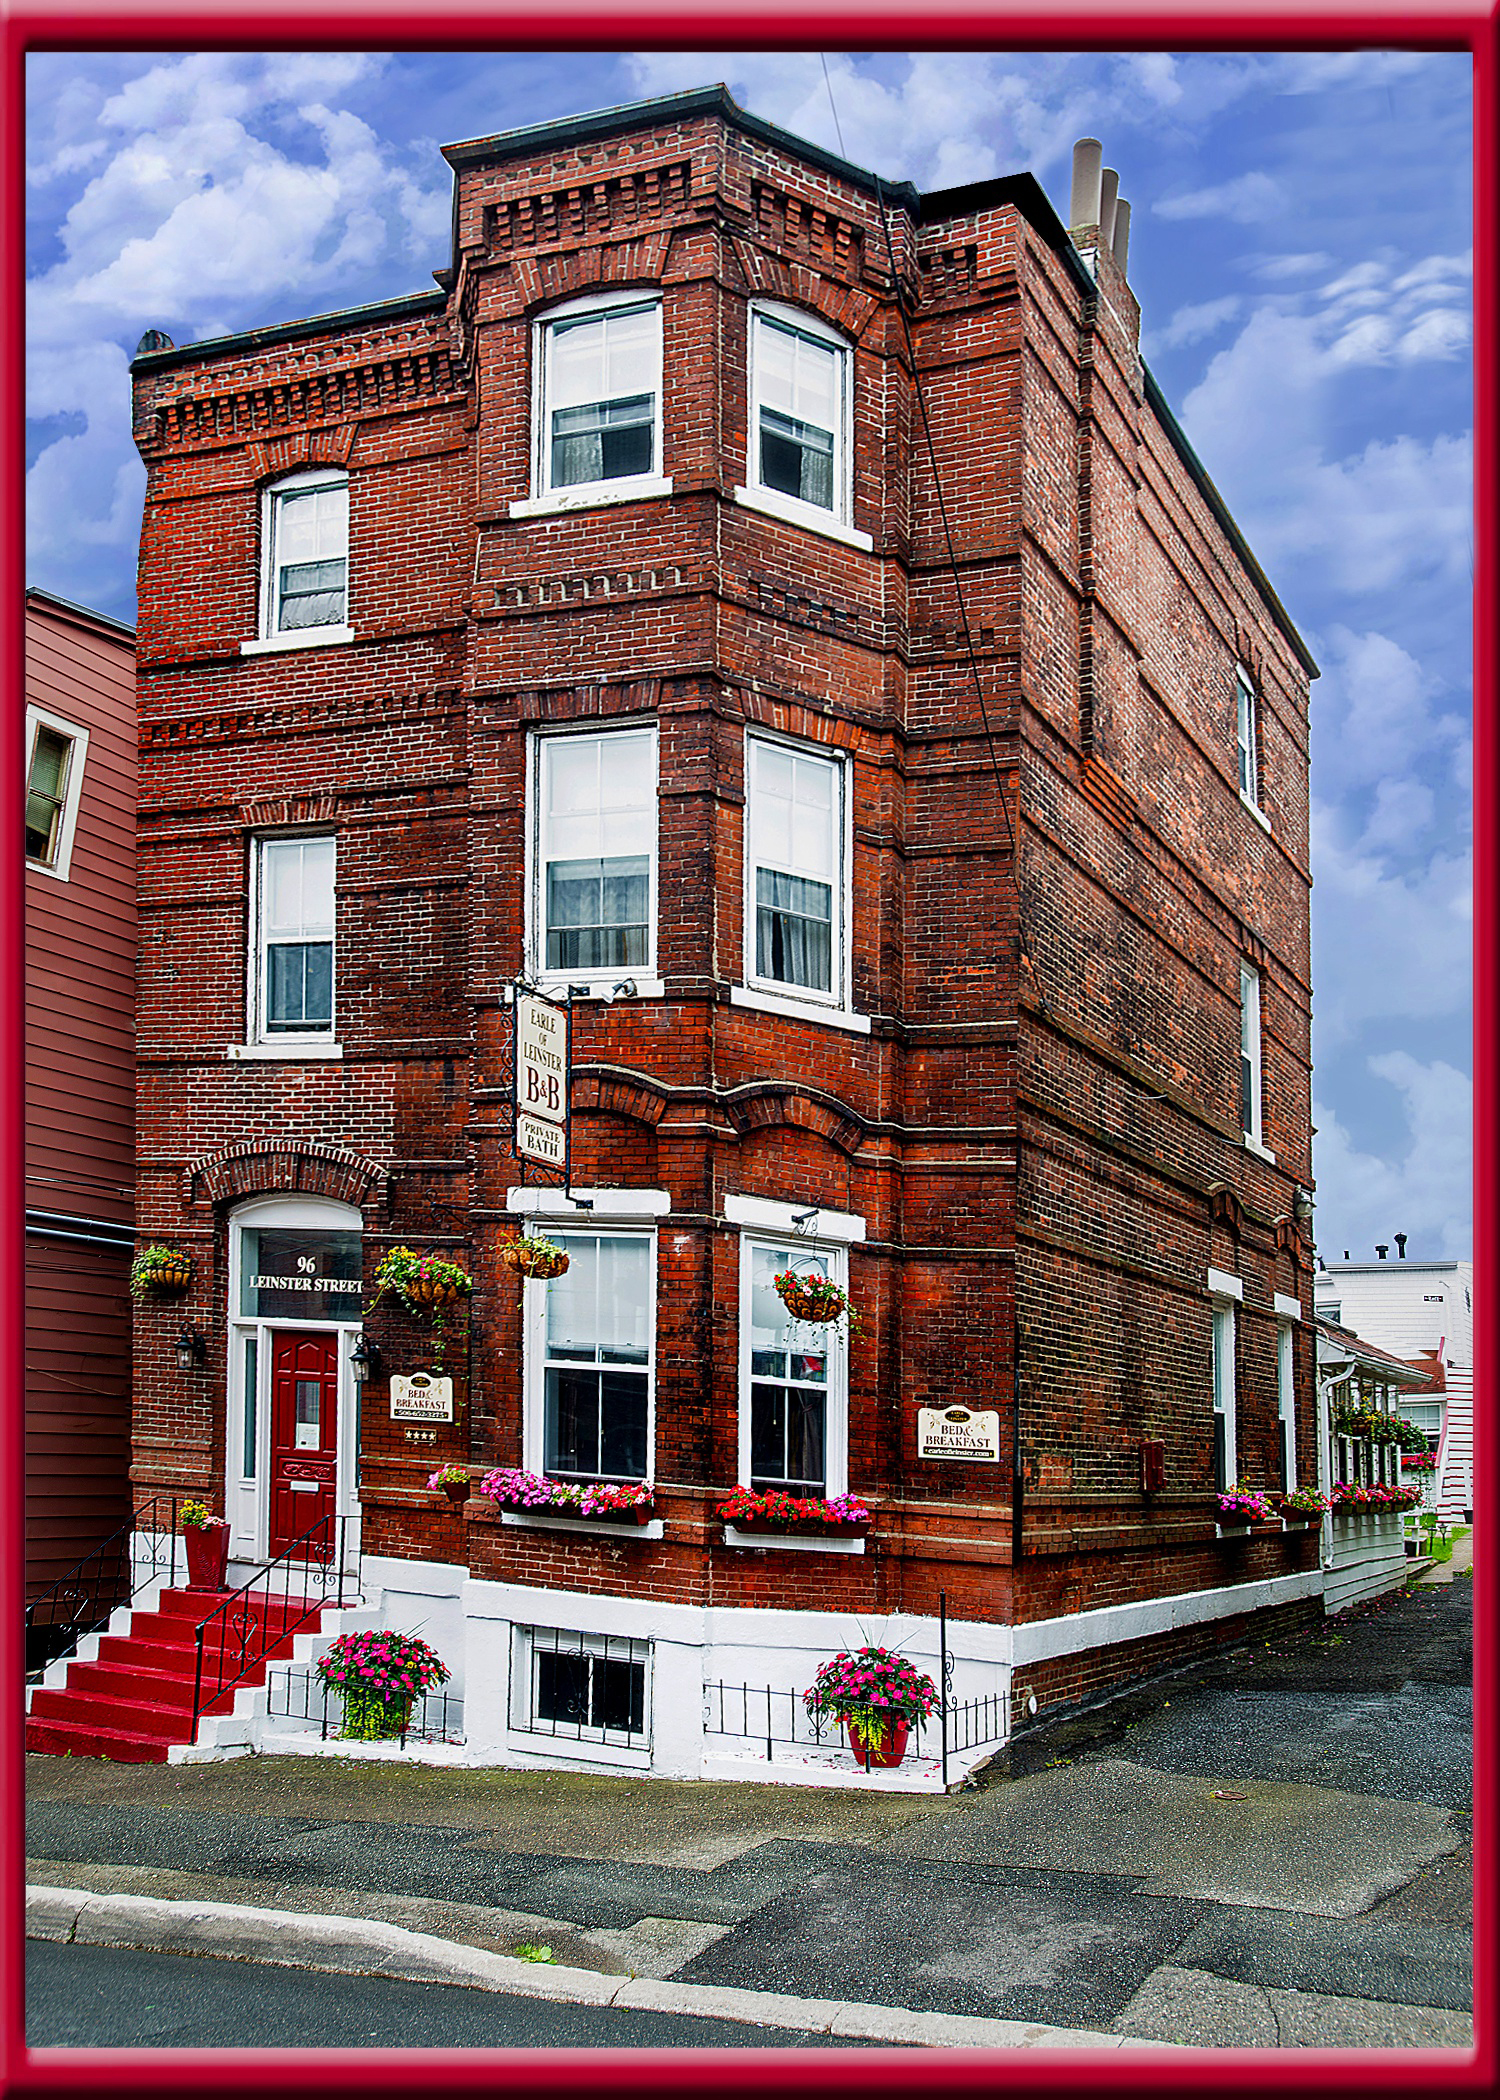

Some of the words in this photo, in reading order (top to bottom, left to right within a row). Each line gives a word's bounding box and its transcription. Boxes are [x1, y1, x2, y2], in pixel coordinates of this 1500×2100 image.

[531, 1009, 556, 1034] EARLE
[538, 1032, 548, 1047] OF
[524, 1042, 562, 1073] LEINSTER
[525, 1122, 561, 1144] PRIVATE
[527, 1134, 559, 1158] BATH
[297, 1256, 316, 1274] 96
[249, 1275, 312, 1291] LEINSTER
[313, 1278, 363, 1293] STREET
[396, 1399, 446, 1410] BREAKFAST
[925, 1435, 990, 1447] BREAKFAST
